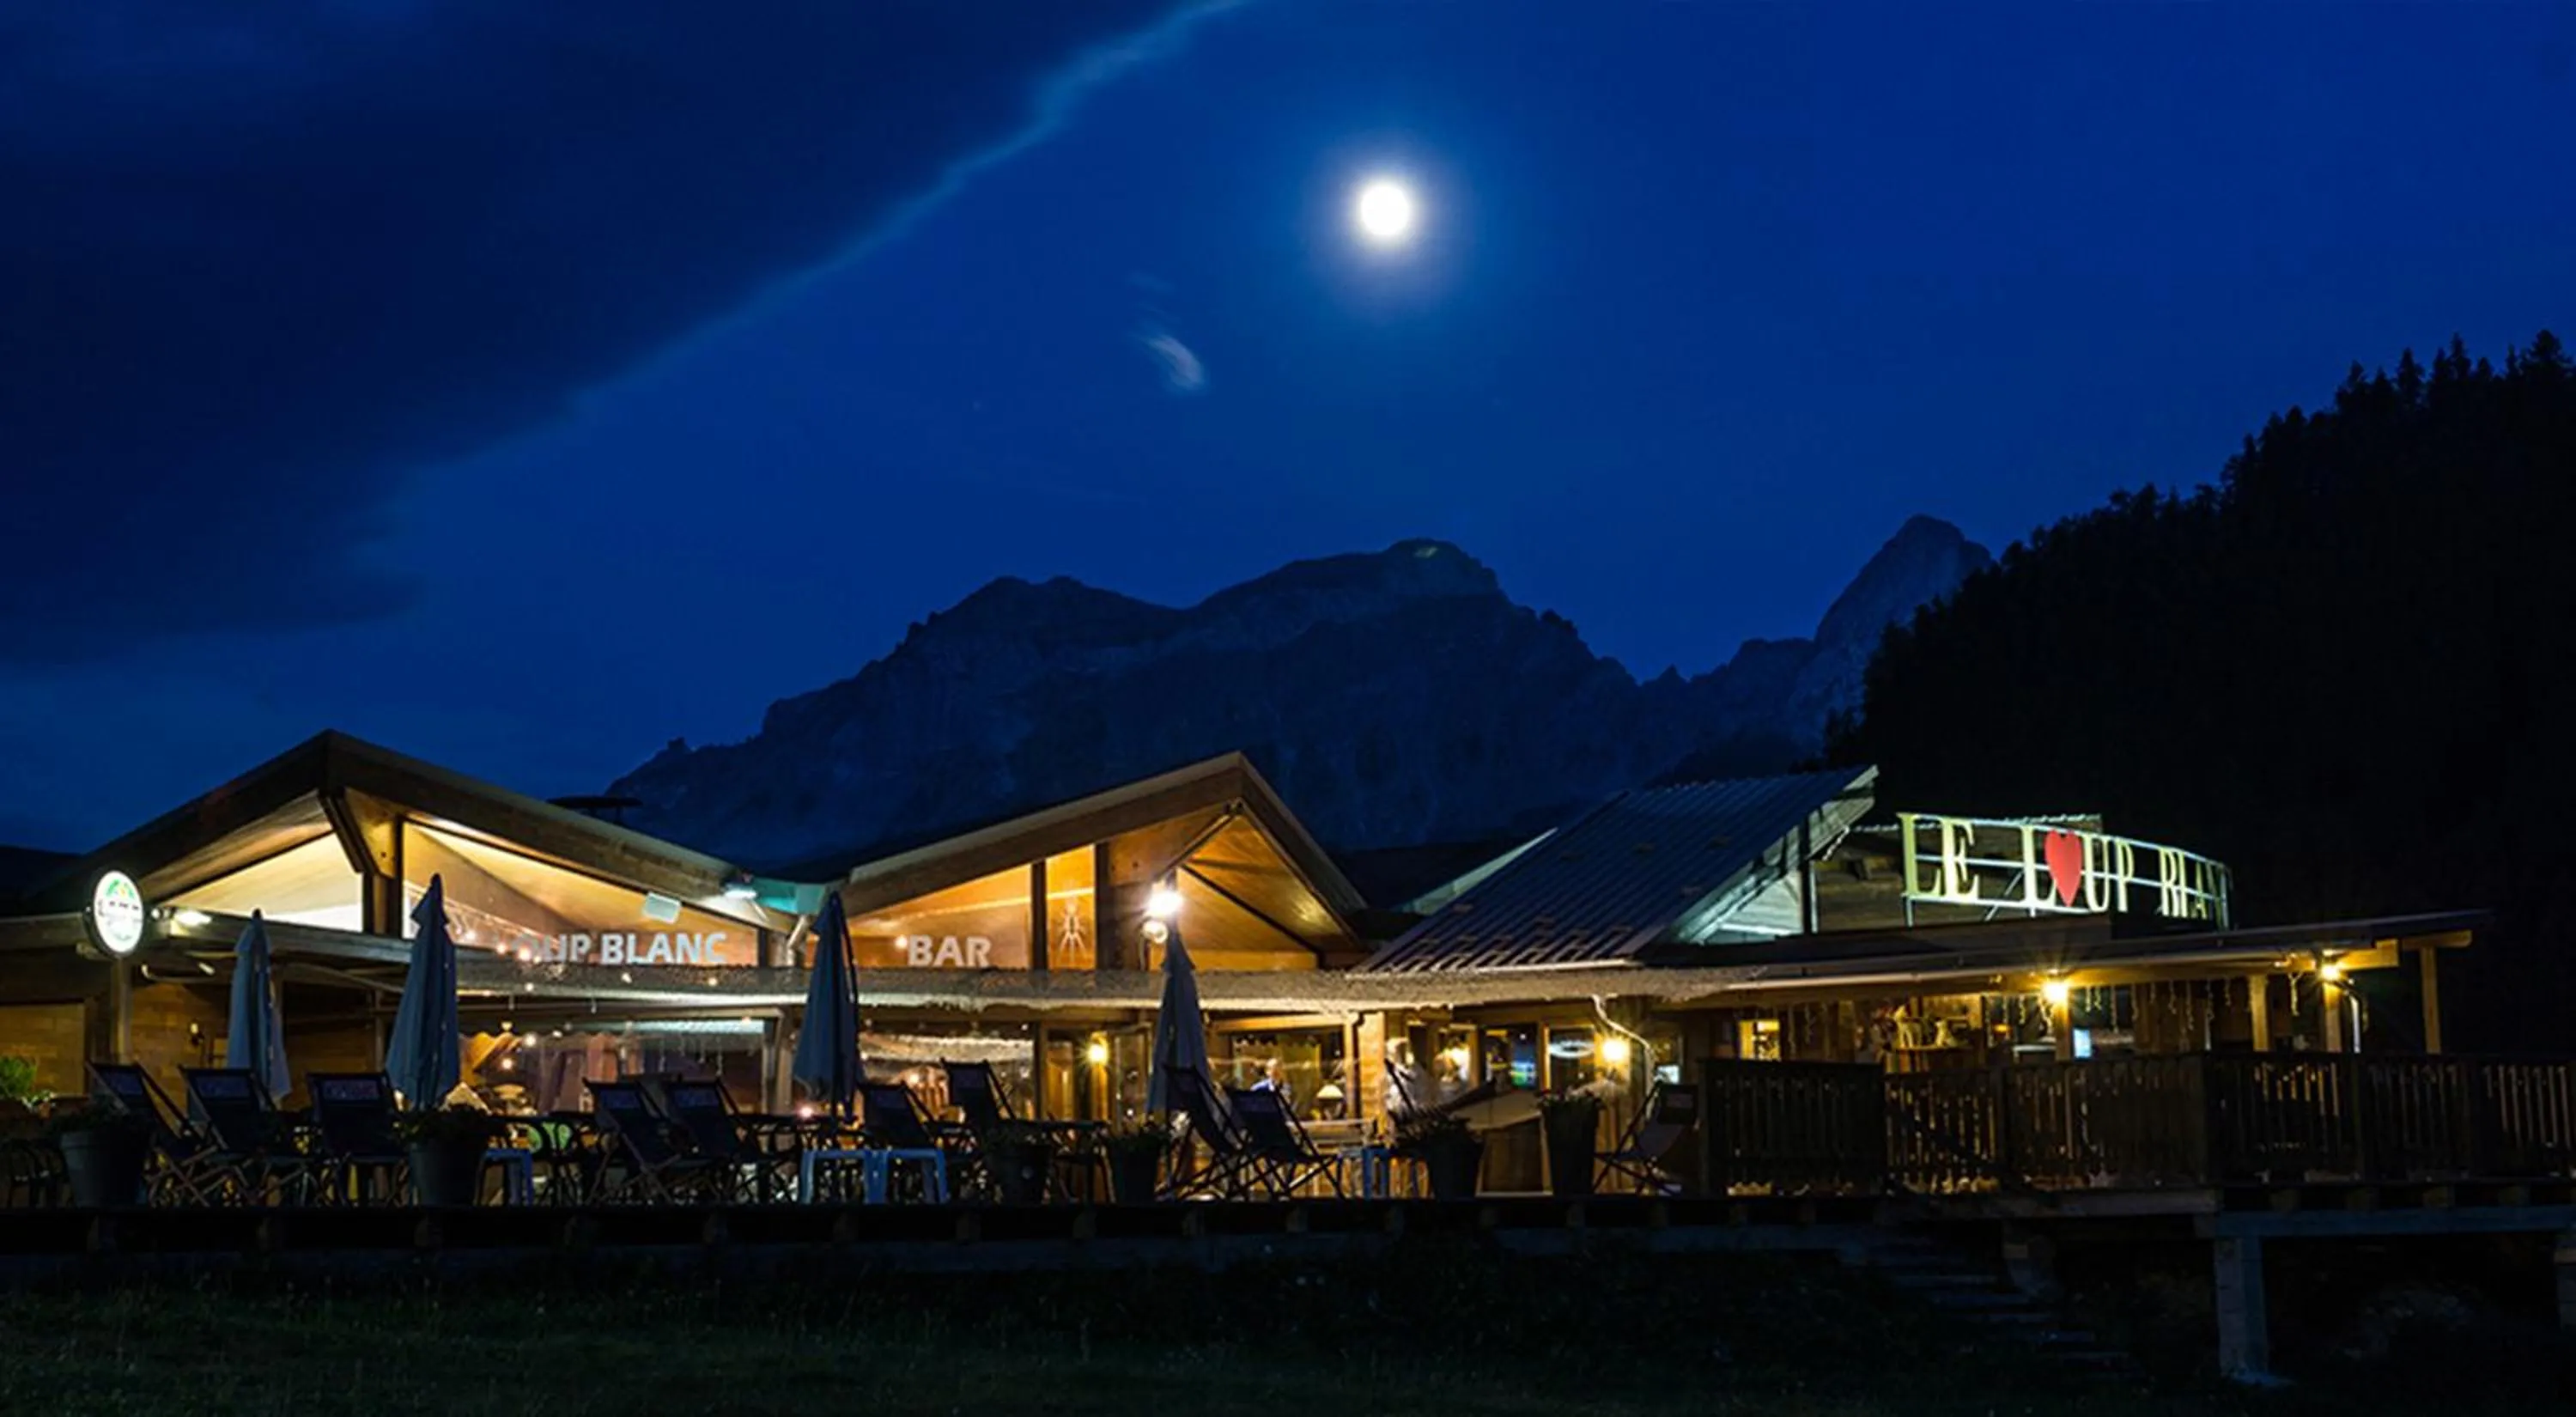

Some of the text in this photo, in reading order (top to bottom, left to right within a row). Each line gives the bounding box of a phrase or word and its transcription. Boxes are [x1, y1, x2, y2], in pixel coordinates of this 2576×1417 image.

[1898, 813, 1980, 899] LE
[601, 932, 726, 964] BLANC
[908, 934, 992, 968] BAR
